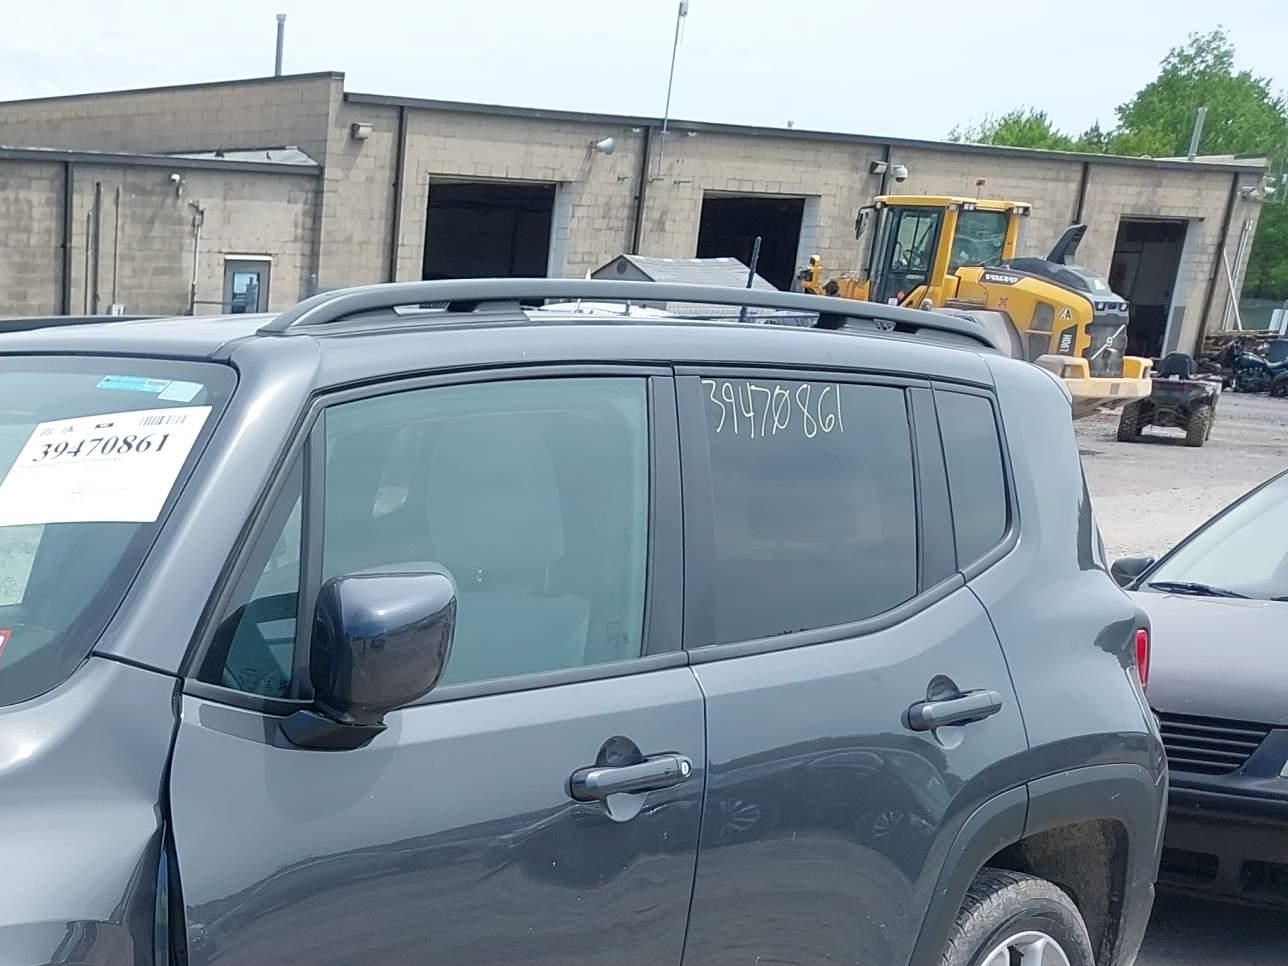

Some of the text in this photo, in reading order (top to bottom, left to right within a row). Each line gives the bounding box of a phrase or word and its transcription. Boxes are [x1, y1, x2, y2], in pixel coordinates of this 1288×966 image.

[985, 273, 1018, 283] VOLVO
[701, 379, 844, 438] 39470861
[32, 433, 169, 462] 39470861
